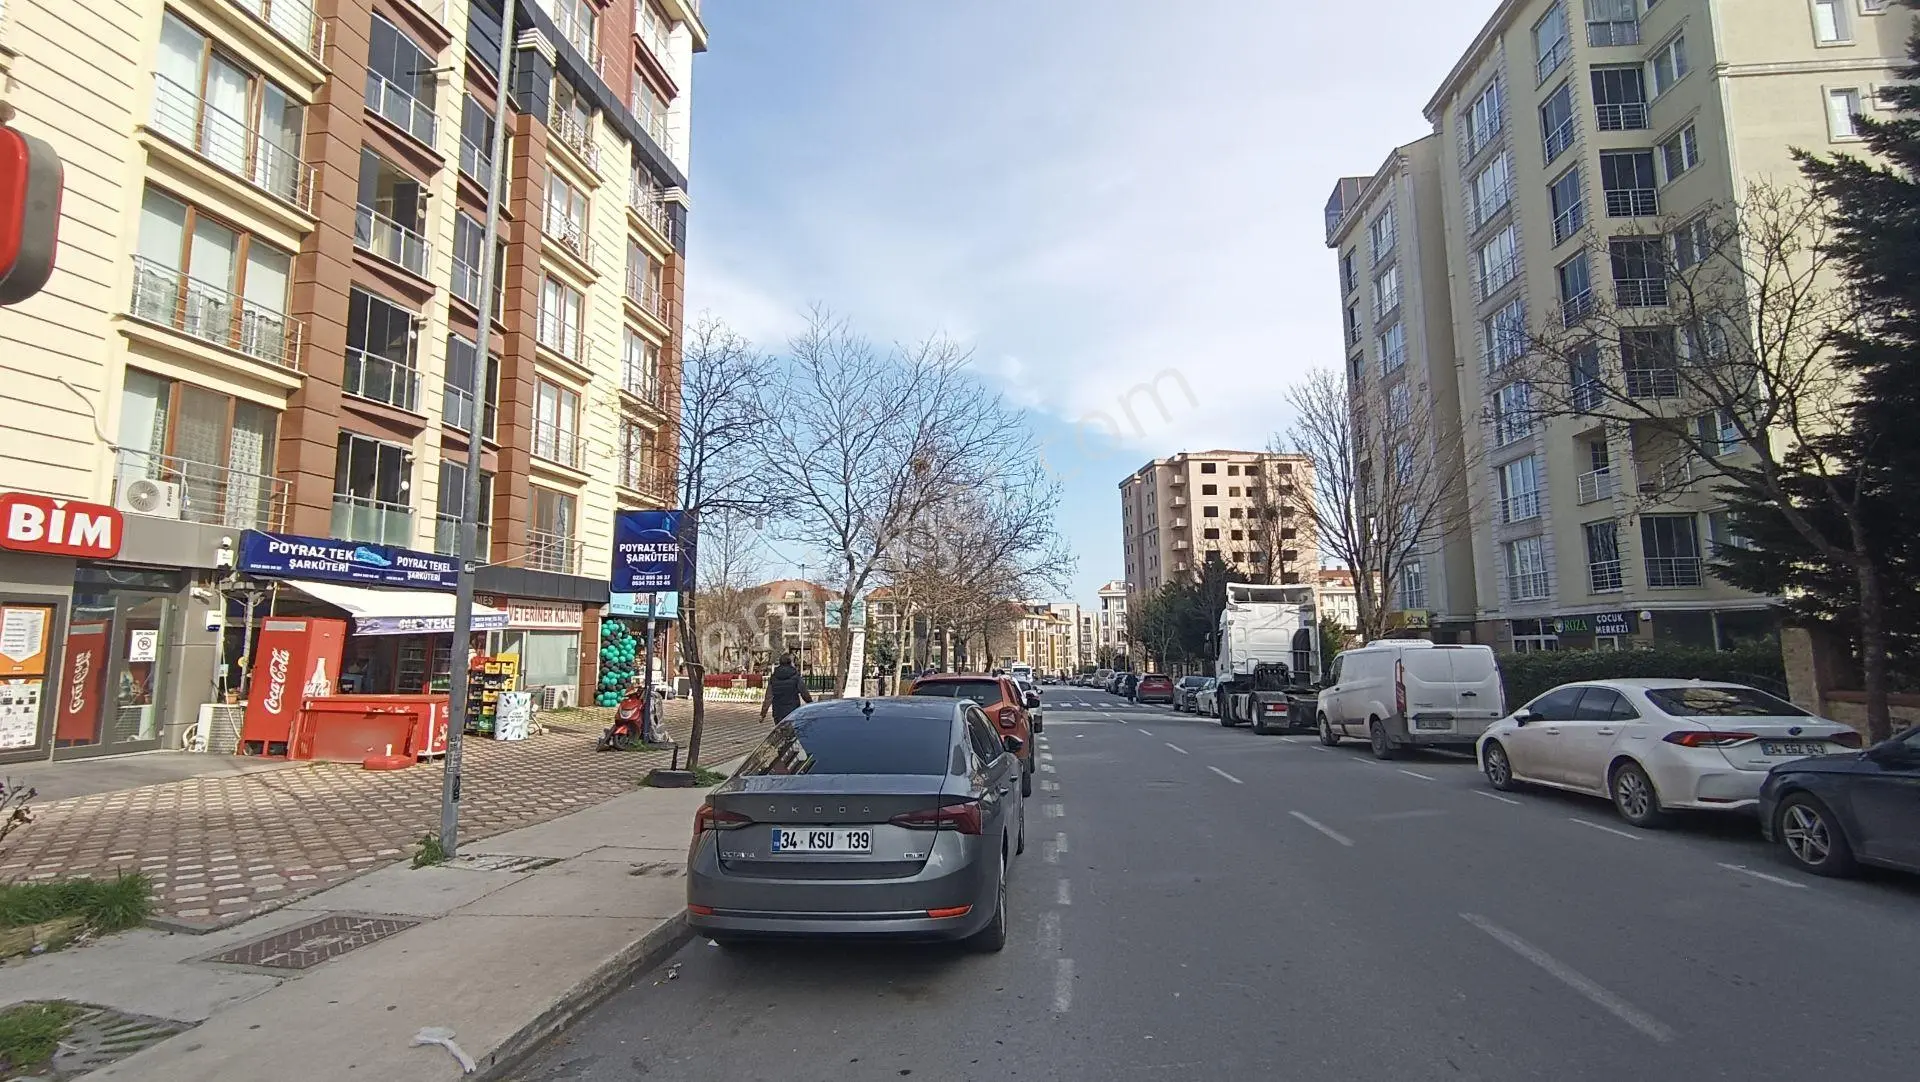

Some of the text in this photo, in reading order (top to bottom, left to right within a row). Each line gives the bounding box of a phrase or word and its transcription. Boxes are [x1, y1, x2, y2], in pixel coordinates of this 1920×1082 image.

[8, 500, 112, 549] BİM
[269, 541, 357, 561] POYRAZ TEK
[620, 543, 679, 552] POYRAZ TEKE
[396, 556, 451, 572] POYRAZ TEKEL
[626, 552, 678, 564] ŞARKÜTERİ
[288, 558, 349, 573] ŞARKÜTERİ
[407, 571, 441, 582] ŞARKÜTERİ
[508, 602, 553, 623] VETERİNER
[1596, 613, 1624, 624] ÇOCUK
[426, 617, 455, 630] TEKE
[1564, 619, 1588, 632] ROZA
[1595, 621, 1629, 634] MERKEZİ
[781, 831, 869, 849] 34 KSU 139
